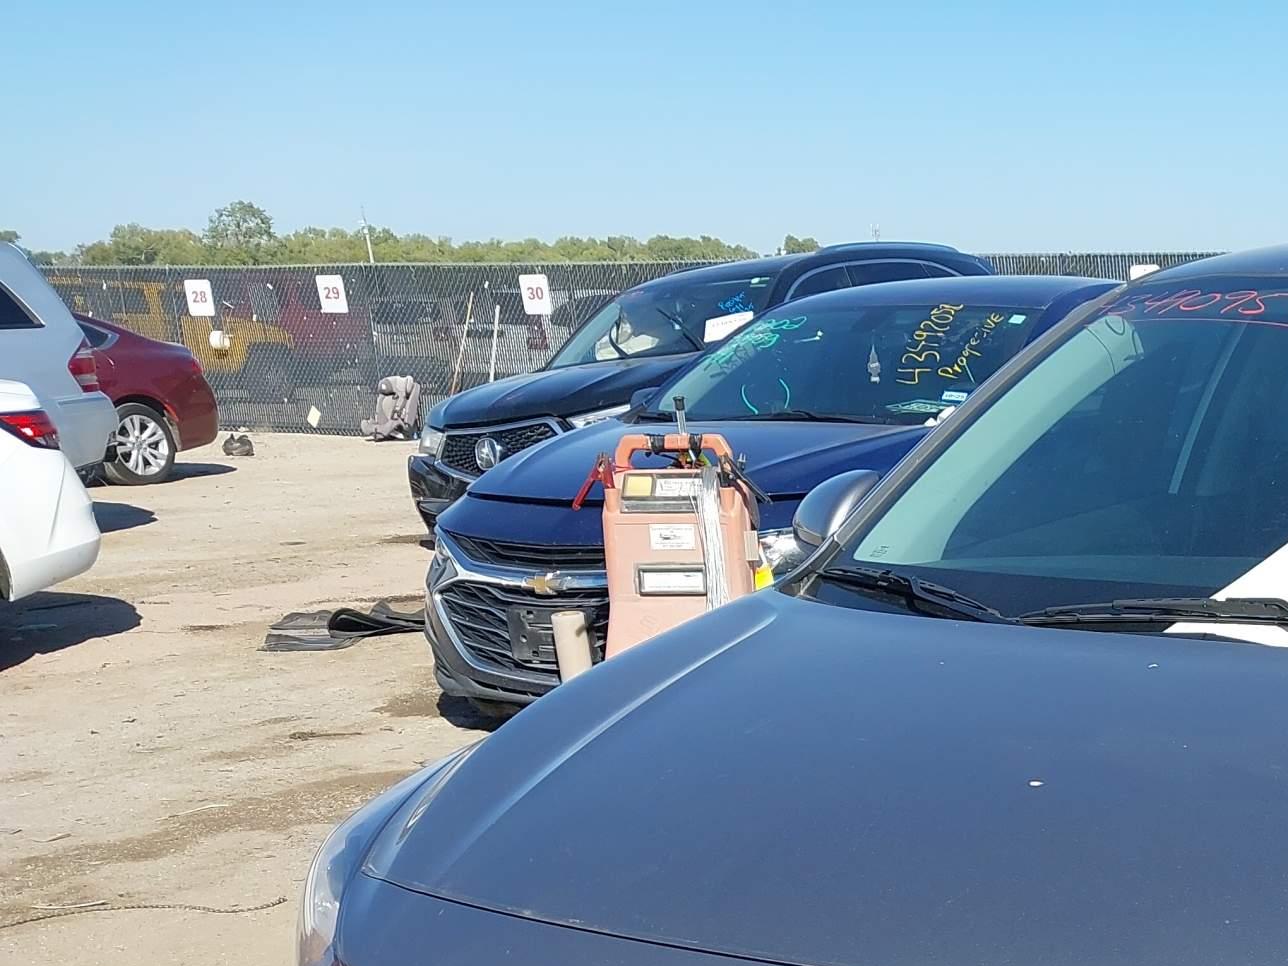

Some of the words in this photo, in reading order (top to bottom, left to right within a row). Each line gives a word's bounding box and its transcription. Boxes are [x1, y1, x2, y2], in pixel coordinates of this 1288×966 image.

[191, 291, 208, 303] 28
[324, 287, 340, 300] 29
[527, 287, 544, 300] 30
